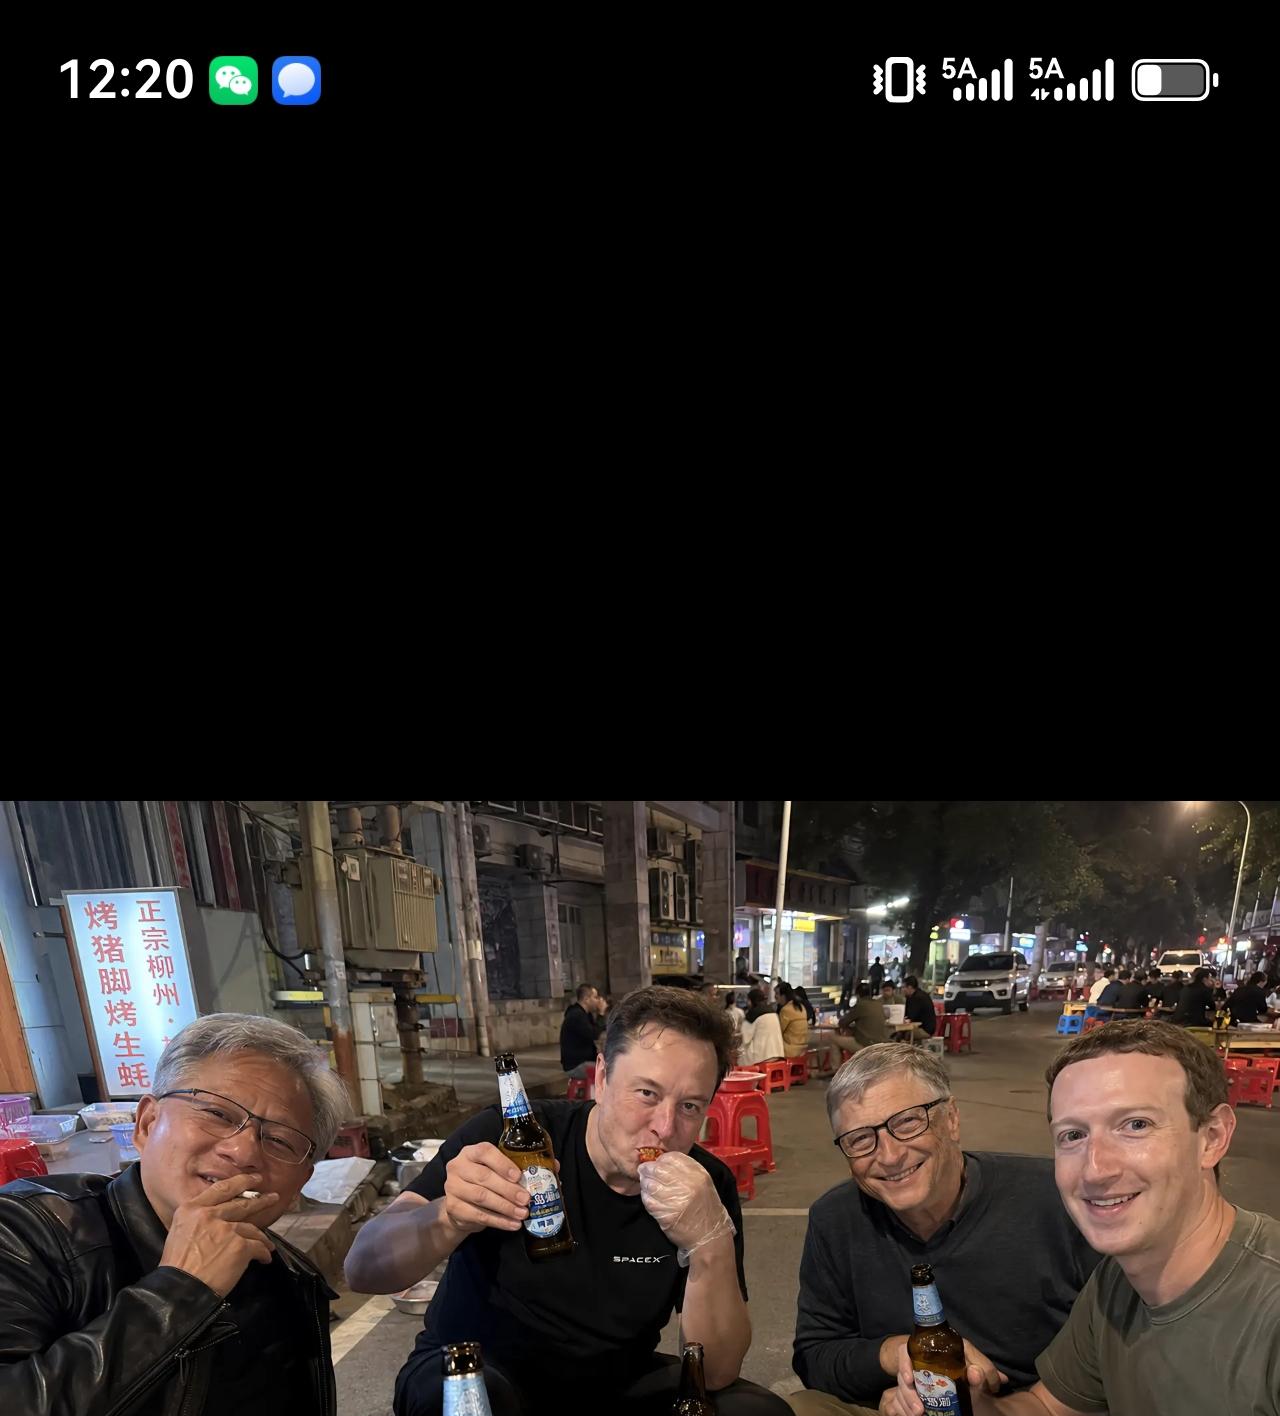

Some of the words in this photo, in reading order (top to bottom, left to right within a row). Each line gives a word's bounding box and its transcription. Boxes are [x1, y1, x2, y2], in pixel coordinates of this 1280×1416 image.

[84, 900, 151, 1088] 烤猪脚烤生蚝
[136, 899, 180, 1046] 正宗柳州·
[612, 1254, 671, 1264] SPACEX
